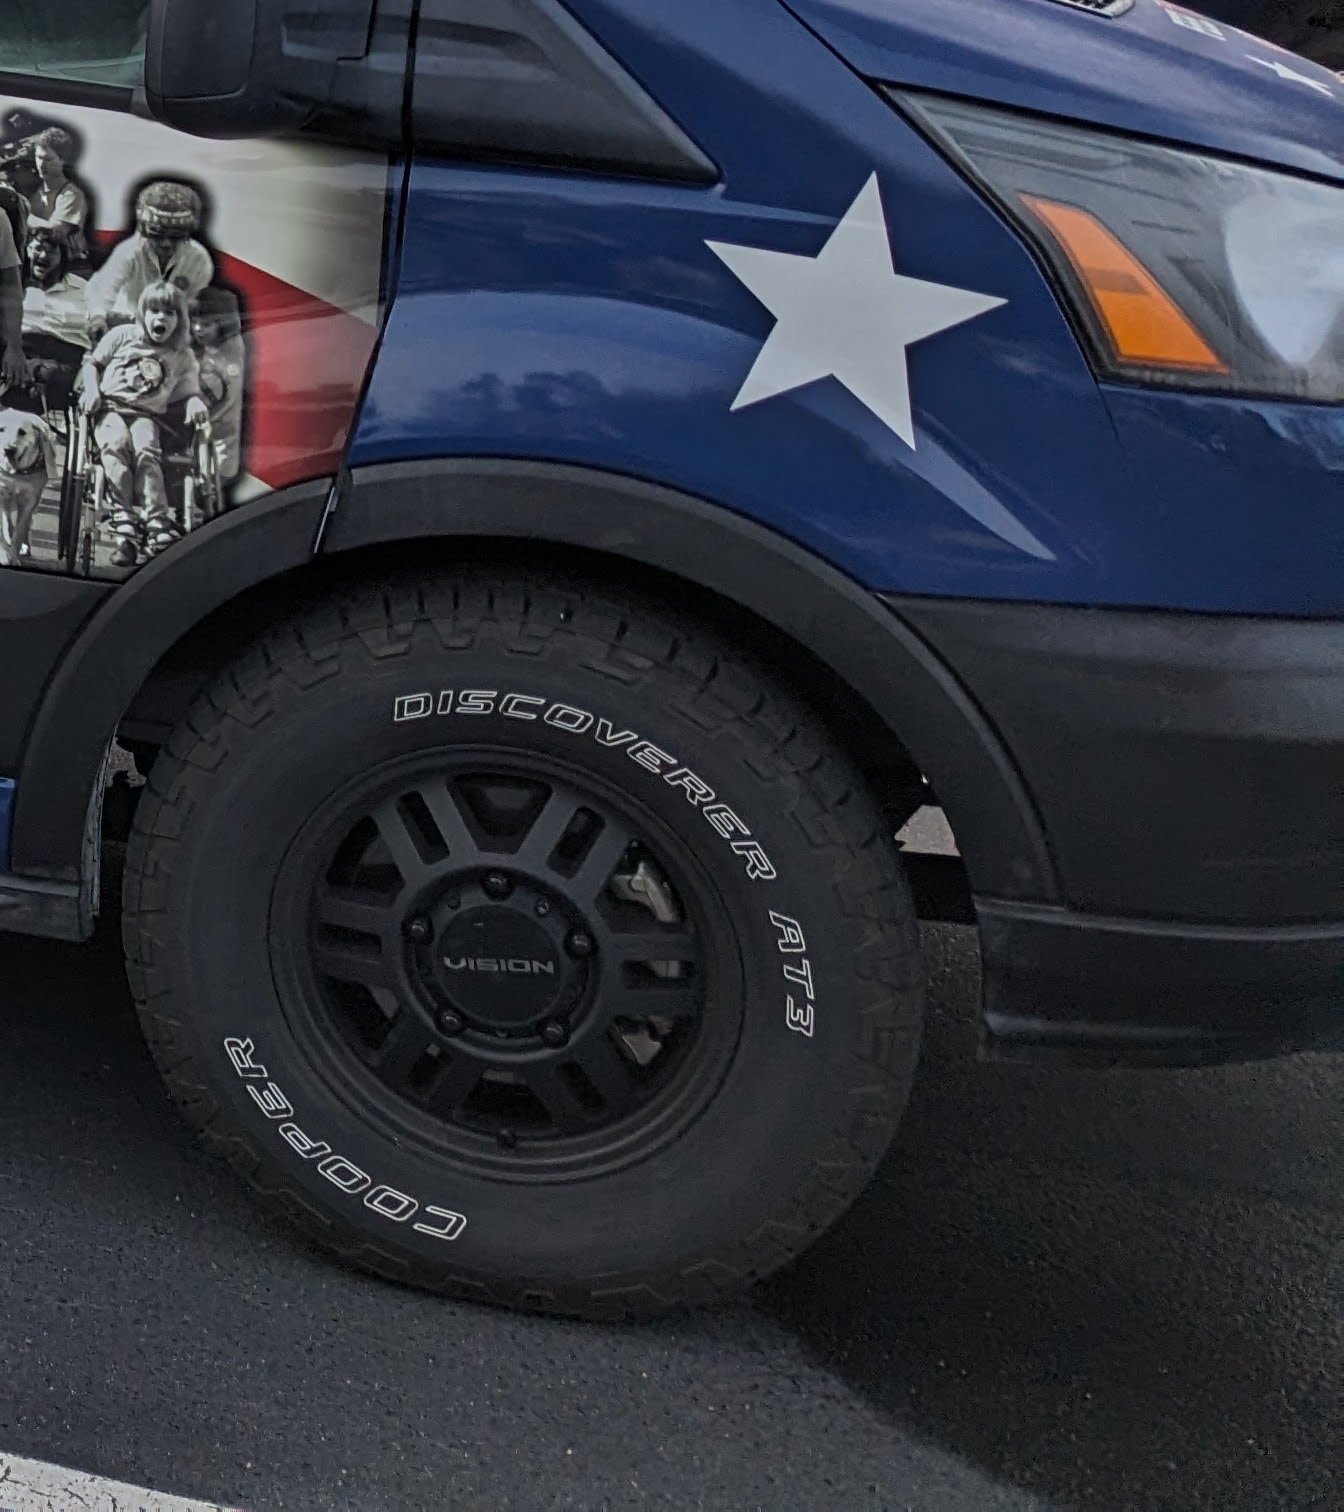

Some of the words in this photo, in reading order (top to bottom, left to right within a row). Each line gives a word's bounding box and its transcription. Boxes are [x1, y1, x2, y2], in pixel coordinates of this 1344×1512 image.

[393, 689, 777, 881] DISCOVERER
[768, 909, 814, 1038] AT3
[442, 955, 555, 976] VISION
[223, 1036, 468, 1242] COOPER
